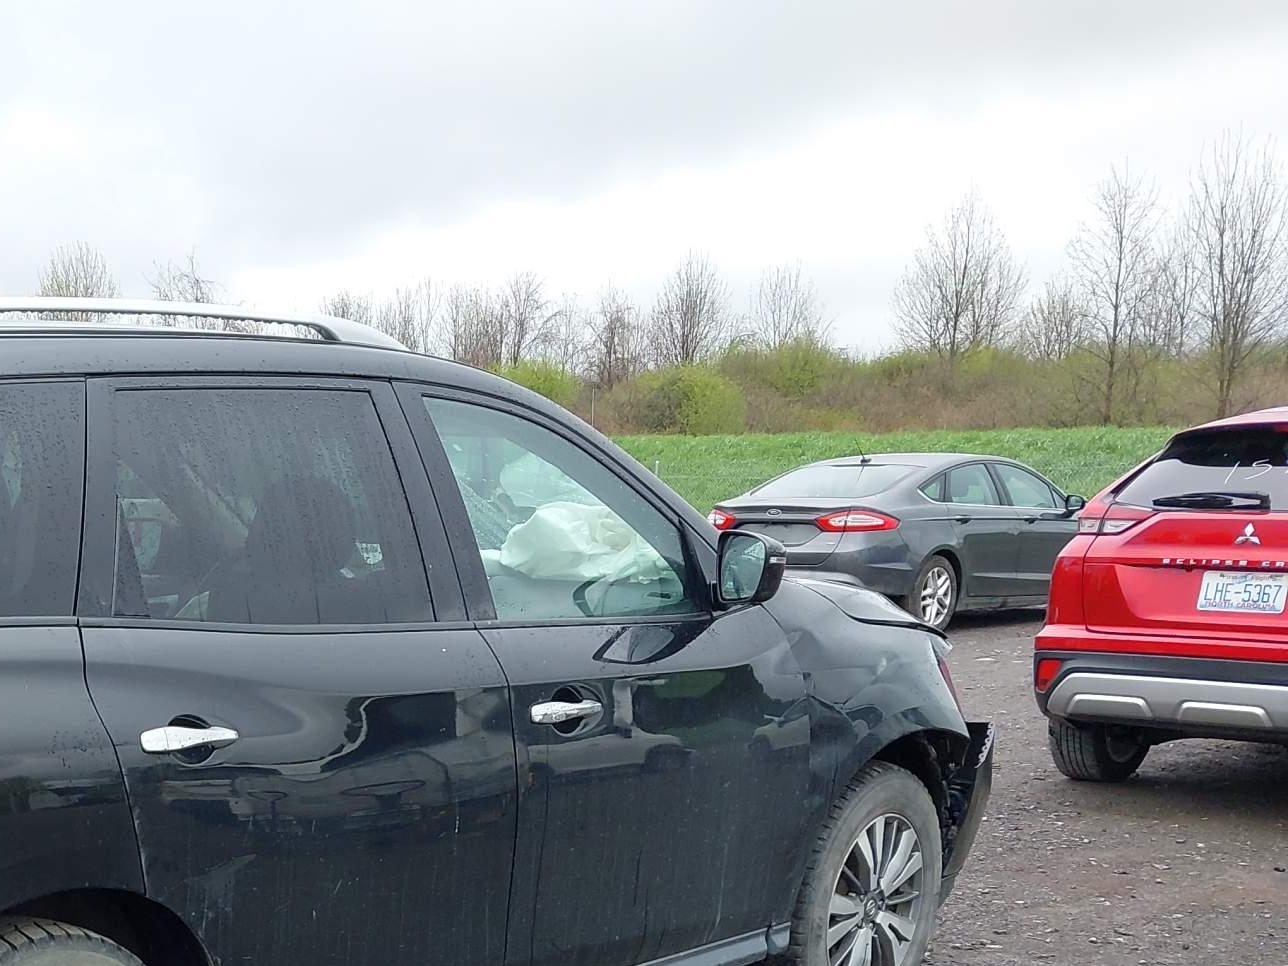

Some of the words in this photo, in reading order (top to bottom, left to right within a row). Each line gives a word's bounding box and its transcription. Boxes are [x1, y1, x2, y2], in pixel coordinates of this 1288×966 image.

[1162, 558, 1248, 566] ECLIPSE
[1203, 582, 1283, 604] LHE-5367
[1204, 600, 1233, 608] NORTH
